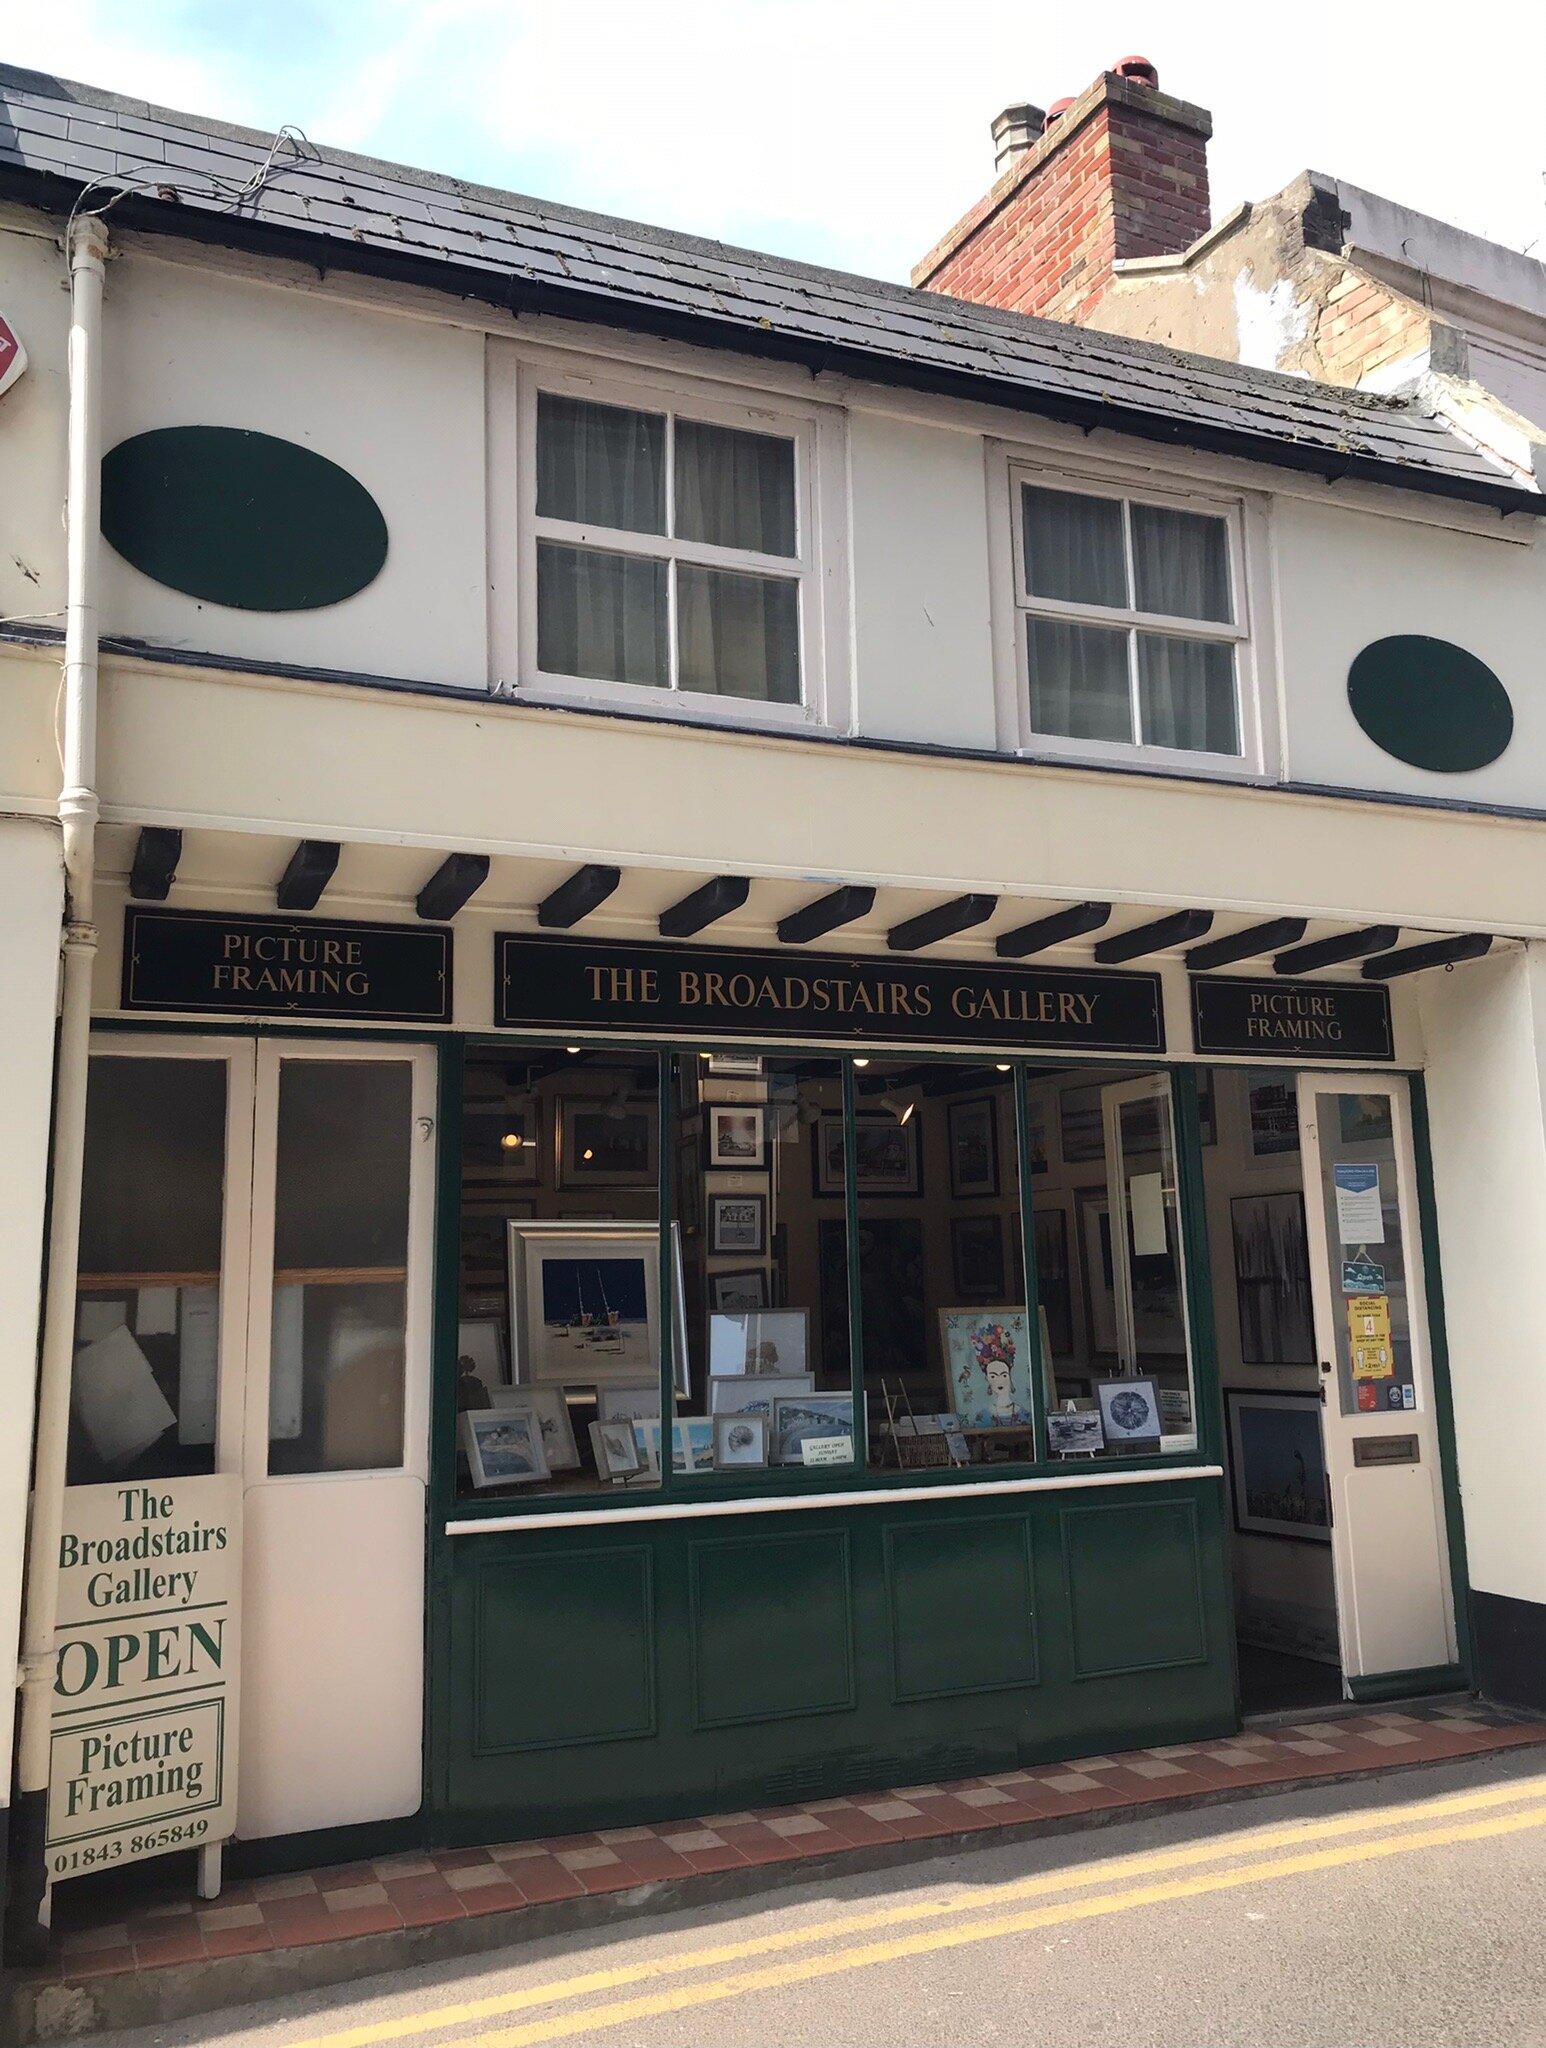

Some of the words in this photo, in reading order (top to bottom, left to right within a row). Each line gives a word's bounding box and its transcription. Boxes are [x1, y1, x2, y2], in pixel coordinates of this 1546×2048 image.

[223, 934, 363, 965] PICTURE
[212, 965, 370, 995] FRAMING
[584, 966, 661, 1003] THE
[677, 971, 932, 1016] BROADSTAIRS
[951, 986, 1100, 1025] GALLERY
[1250, 994, 1336, 1016] PICTURE
[1247, 1018, 1342, 1040] FRAMING
[118, 1488, 174, 1522] The
[59, 1520, 227, 1569] Broadstairs
[87, 1567, 198, 1608] Gallery
[53, 1618, 228, 1697] OPEN
[78, 1726, 194, 1775] Picture
[65, 1760, 203, 1818] Framing
[54, 1840, 122, 1873] 01843
[130, 1819, 209, 1854] 865849
